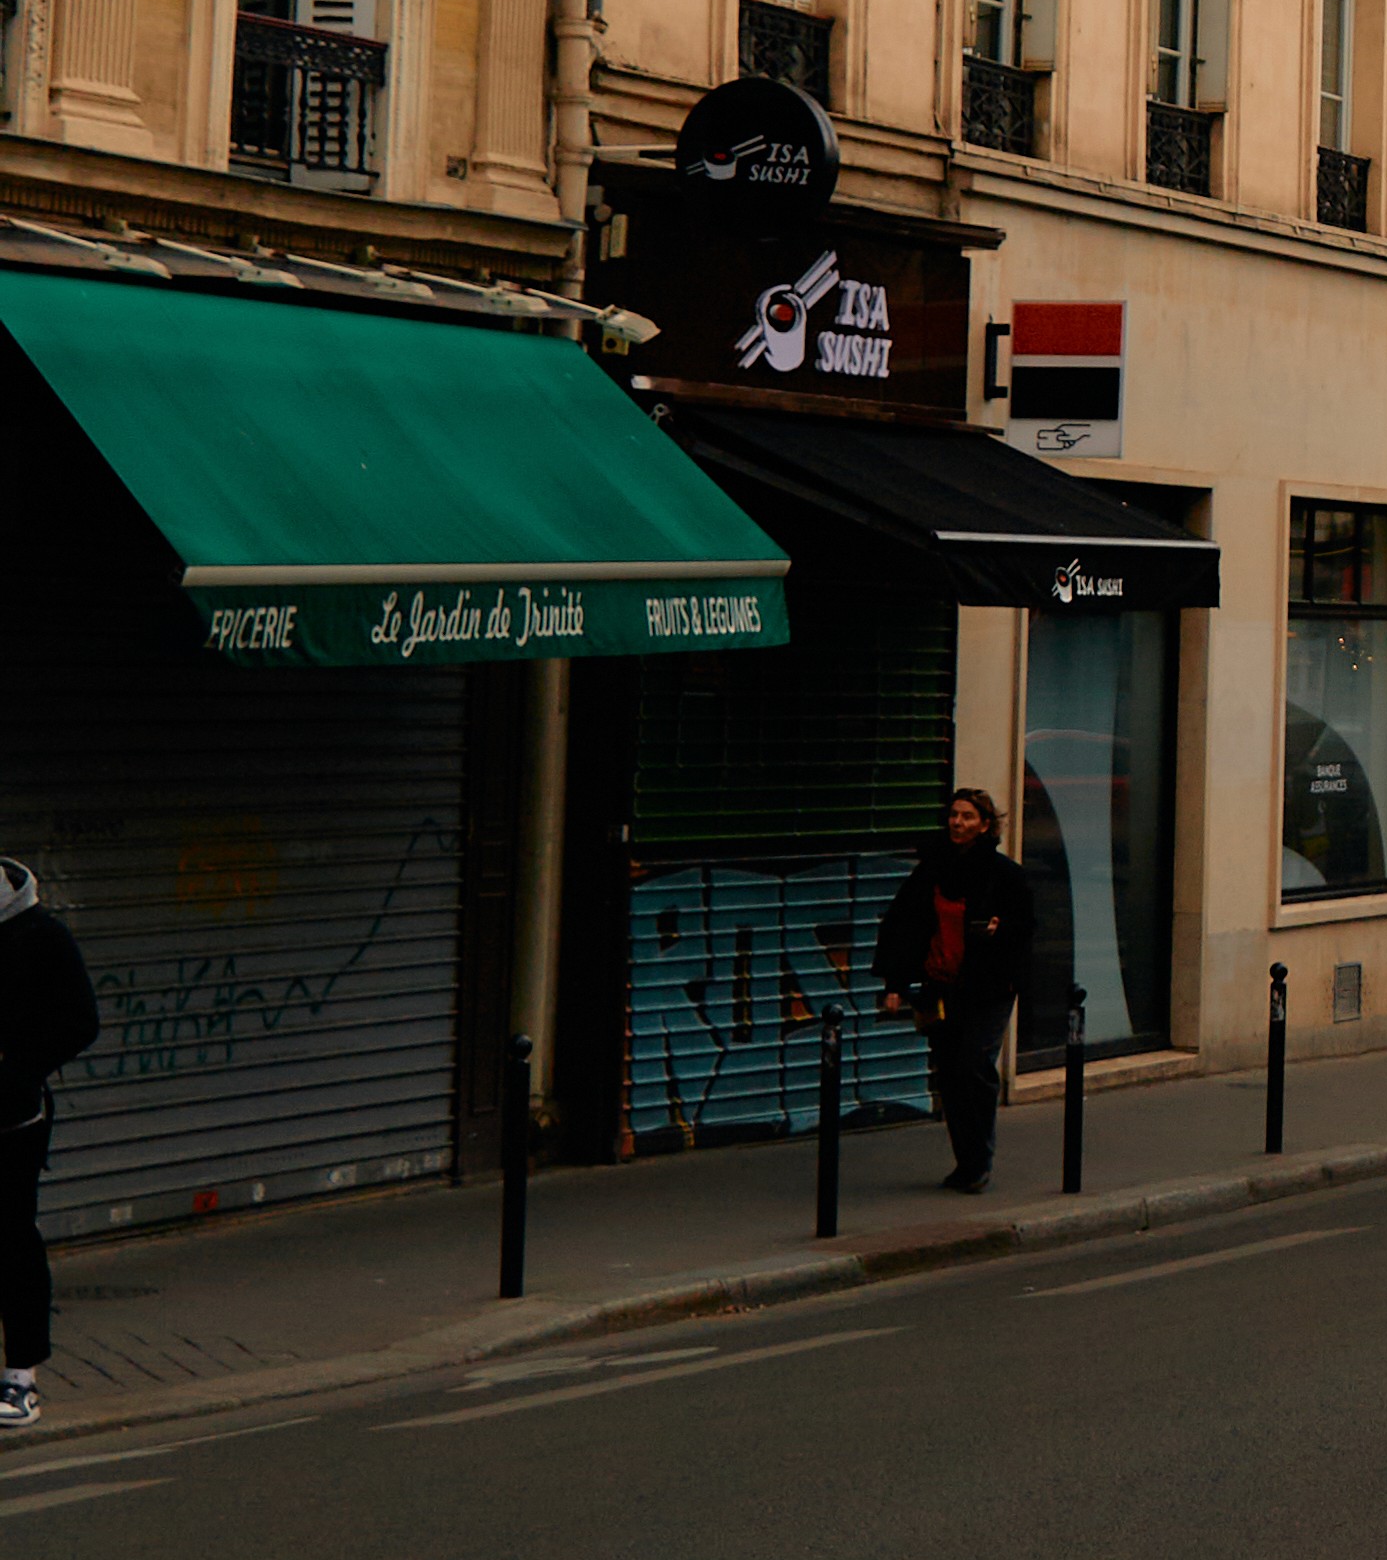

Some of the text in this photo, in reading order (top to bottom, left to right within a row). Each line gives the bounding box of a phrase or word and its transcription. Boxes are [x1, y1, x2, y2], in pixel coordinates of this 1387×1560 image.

[749, 164, 812, 186] SUSHI
[767, 143, 810, 165] ISA
[834, 280, 890, 331] ISA
[815, 331, 893, 378] SUSHI
[1076, 574, 1095, 596] ISA
[203, 605, 298, 651] EPICERIE
[371, 591, 402, 644] Le
[401, 589, 482, 658] Jardin
[484, 587, 512, 640] de
[646, 596, 690, 638] FRUITS
[690, 595, 703, 636] &
